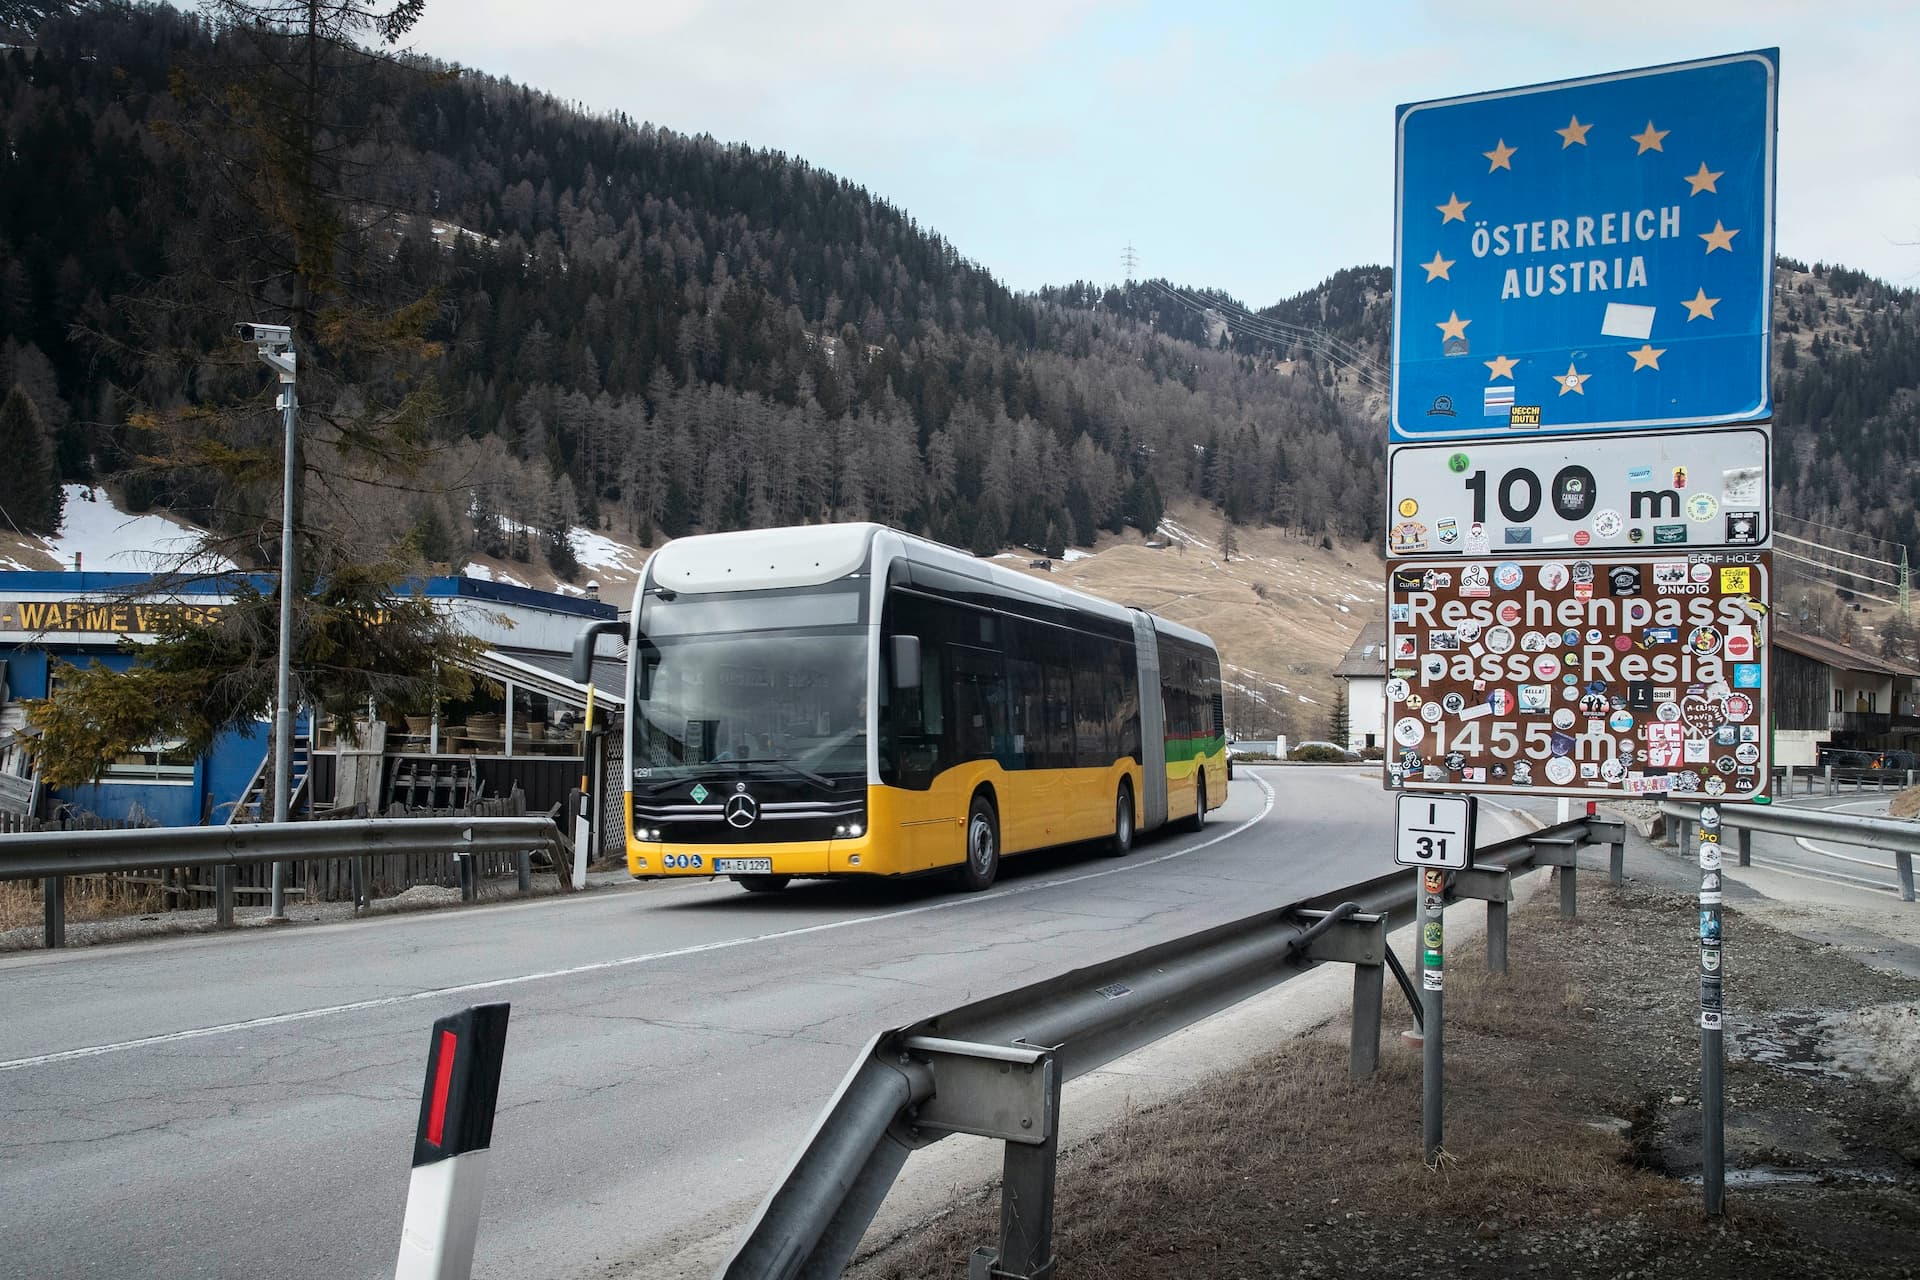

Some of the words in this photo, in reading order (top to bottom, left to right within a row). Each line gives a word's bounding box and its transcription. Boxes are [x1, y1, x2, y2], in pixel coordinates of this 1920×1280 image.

[1471, 205, 1680, 258] ÖSTERREICH
[1501, 255, 1648, 299] AUSTRIA
[1465, 465, 1596, 523] 100
[1630, 489, 1680, 519] m
[18, 602, 128, 631] WARME
[1408, 589, 1746, 634] Reschenpass
[1420, 652, 1562, 688] passo
[1583, 644, 1725, 683] Resia
[1430, 720, 1553, 760] 1455
[1575, 731, 1617, 761] m
[737, 860, 748, 871] EV
[749, 860, 770, 871] 1291
[1415, 836, 1447, 861] 31
